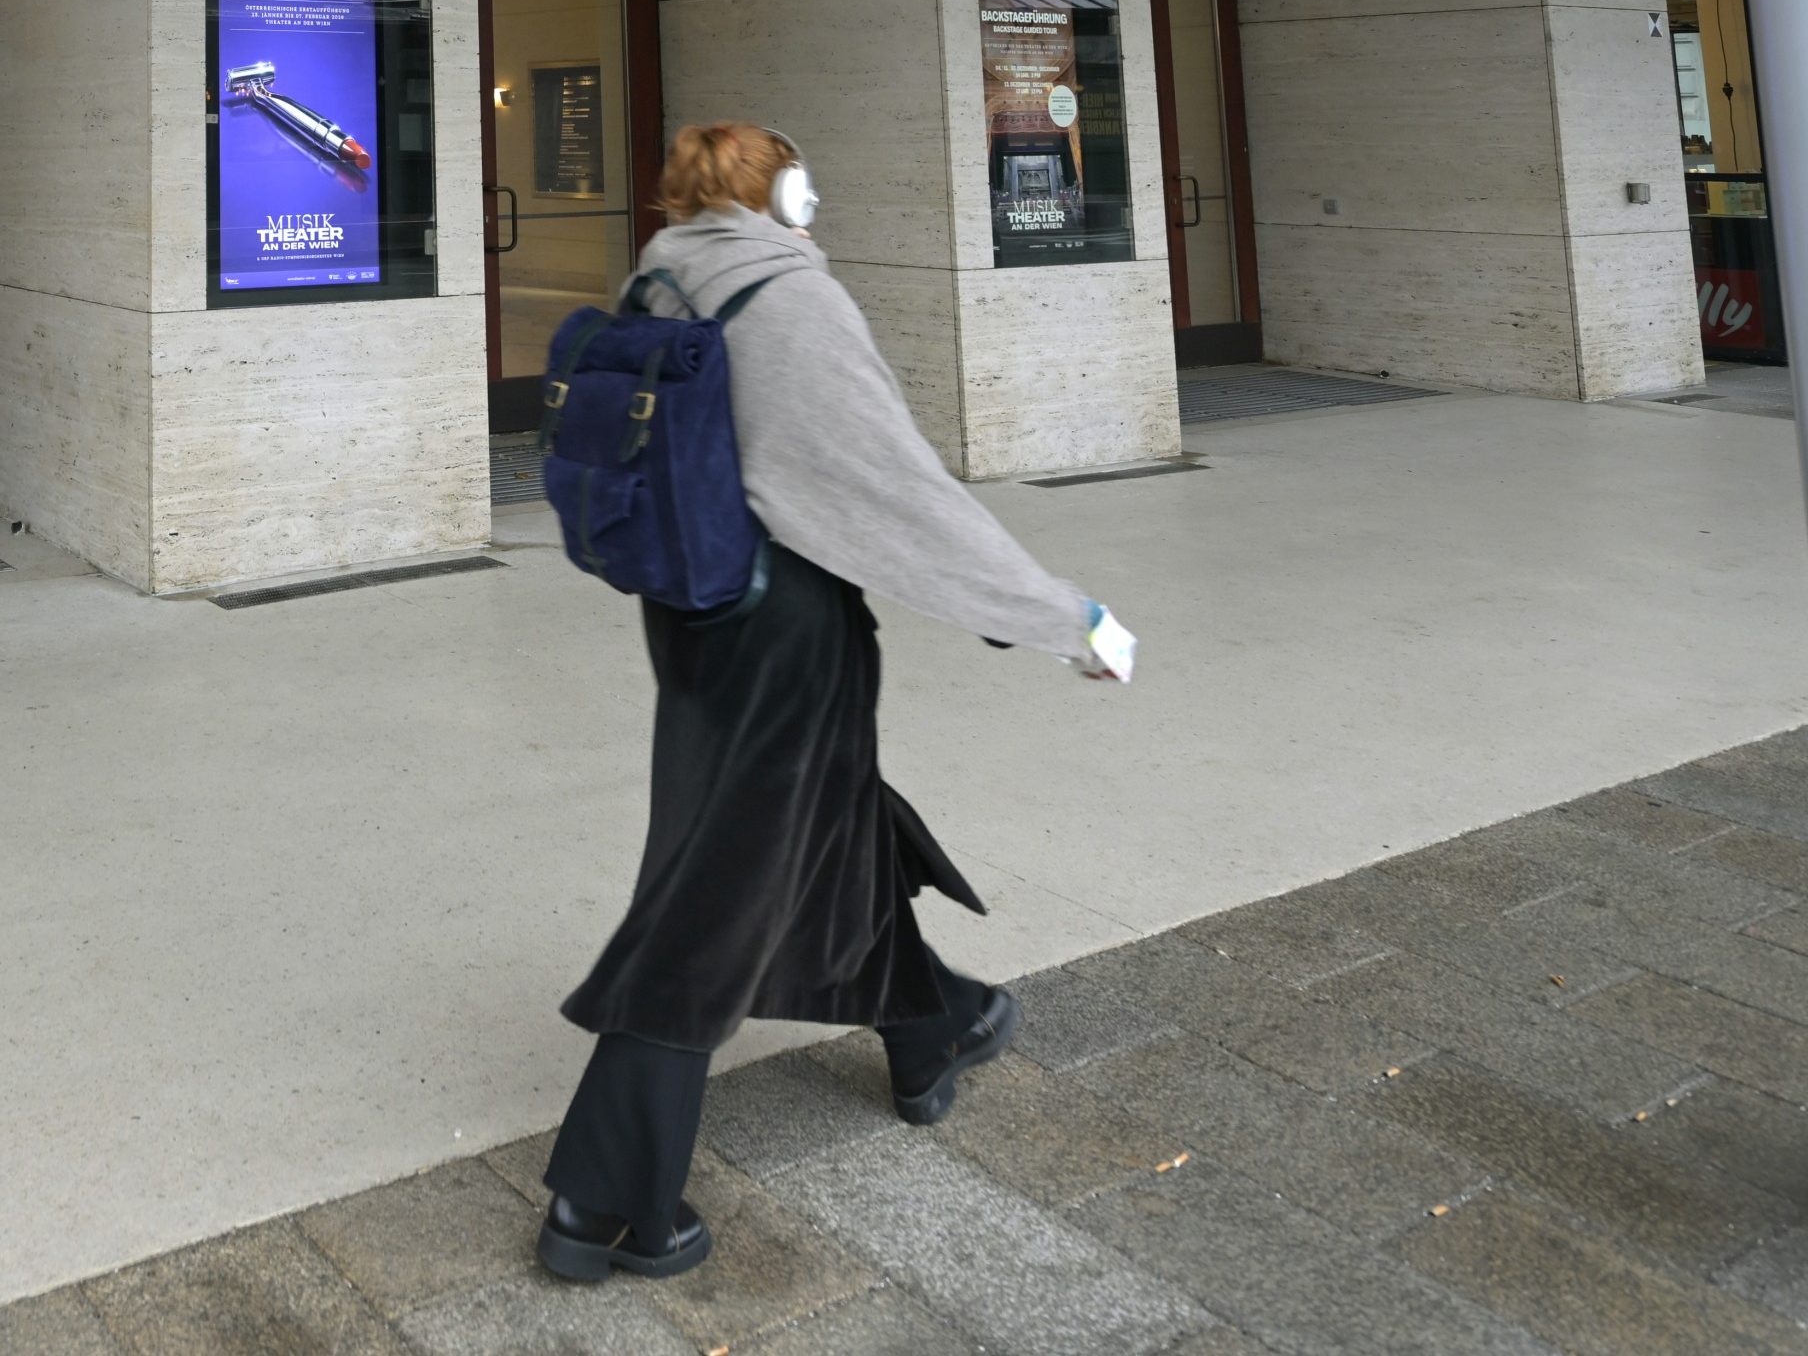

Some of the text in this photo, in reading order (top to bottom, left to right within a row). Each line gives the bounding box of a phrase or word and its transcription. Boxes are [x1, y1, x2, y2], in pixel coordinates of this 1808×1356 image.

[981, 10, 1068, 24] BACKSTAGEFÜHRUNG
[993, 25, 1058, 35] BACKSTAGE GUIDED TOUR
[1013, 199, 1058, 214] MUSIK
[266, 213, 335, 233] MUSIK
[1007, 211, 1065, 223] THEATER
[256, 227, 344, 243] THEATER
[263, 241, 339, 251] AN DER WIEN
[1696, 281, 1753, 338] lly
